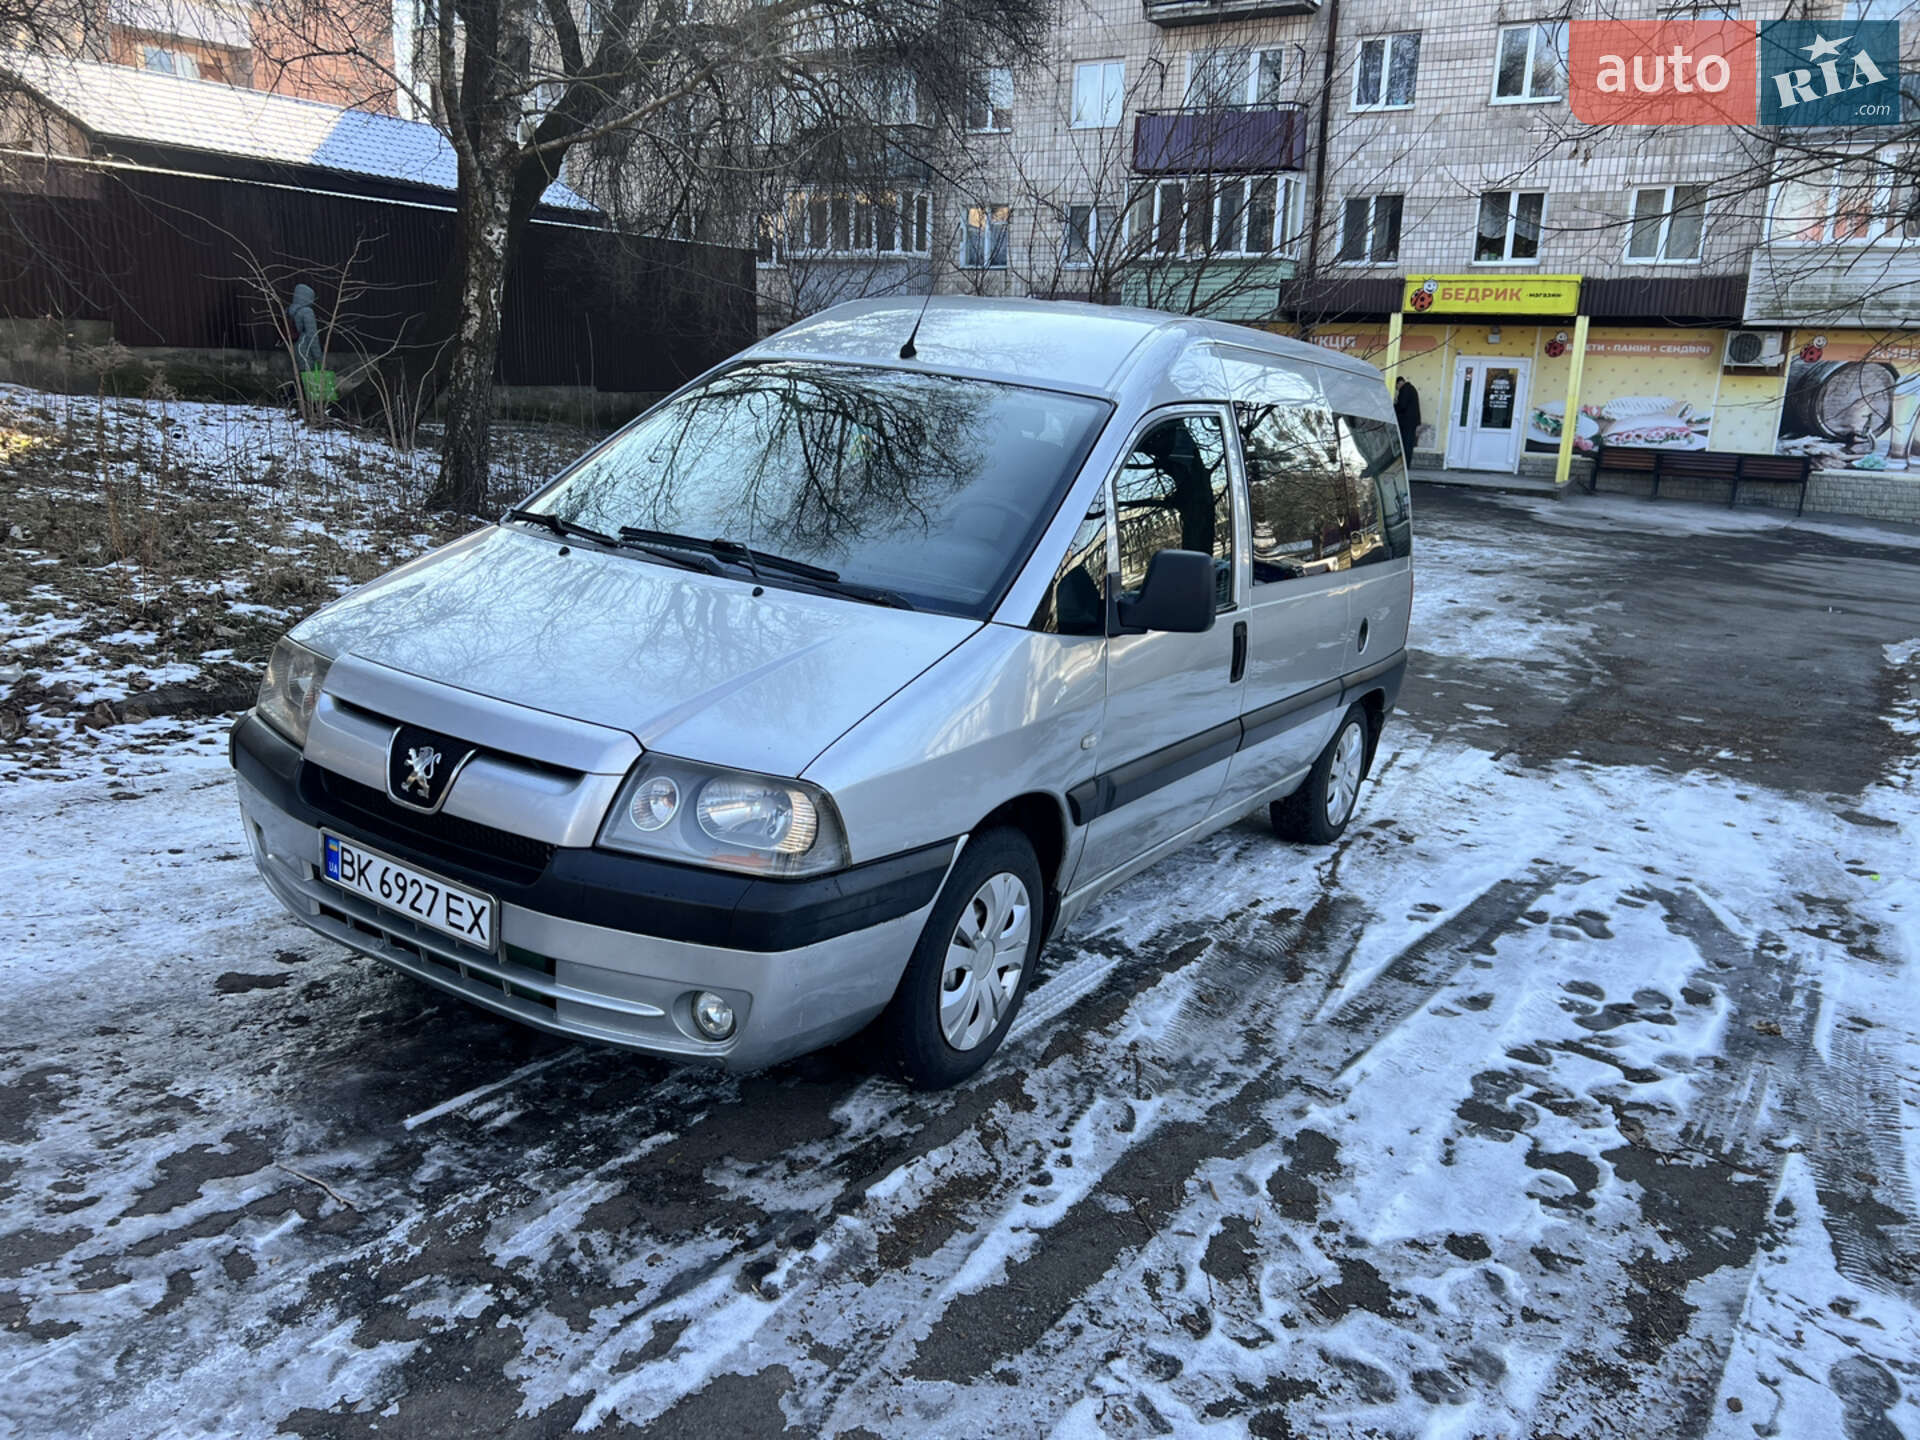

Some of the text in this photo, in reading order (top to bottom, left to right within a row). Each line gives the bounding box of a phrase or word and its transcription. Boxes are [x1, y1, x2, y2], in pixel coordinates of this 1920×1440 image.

[1441, 287, 1523, 303] БЕДРИК
[328, 861, 338, 874] UA
[340, 846, 487, 940] BK 6927 EX
